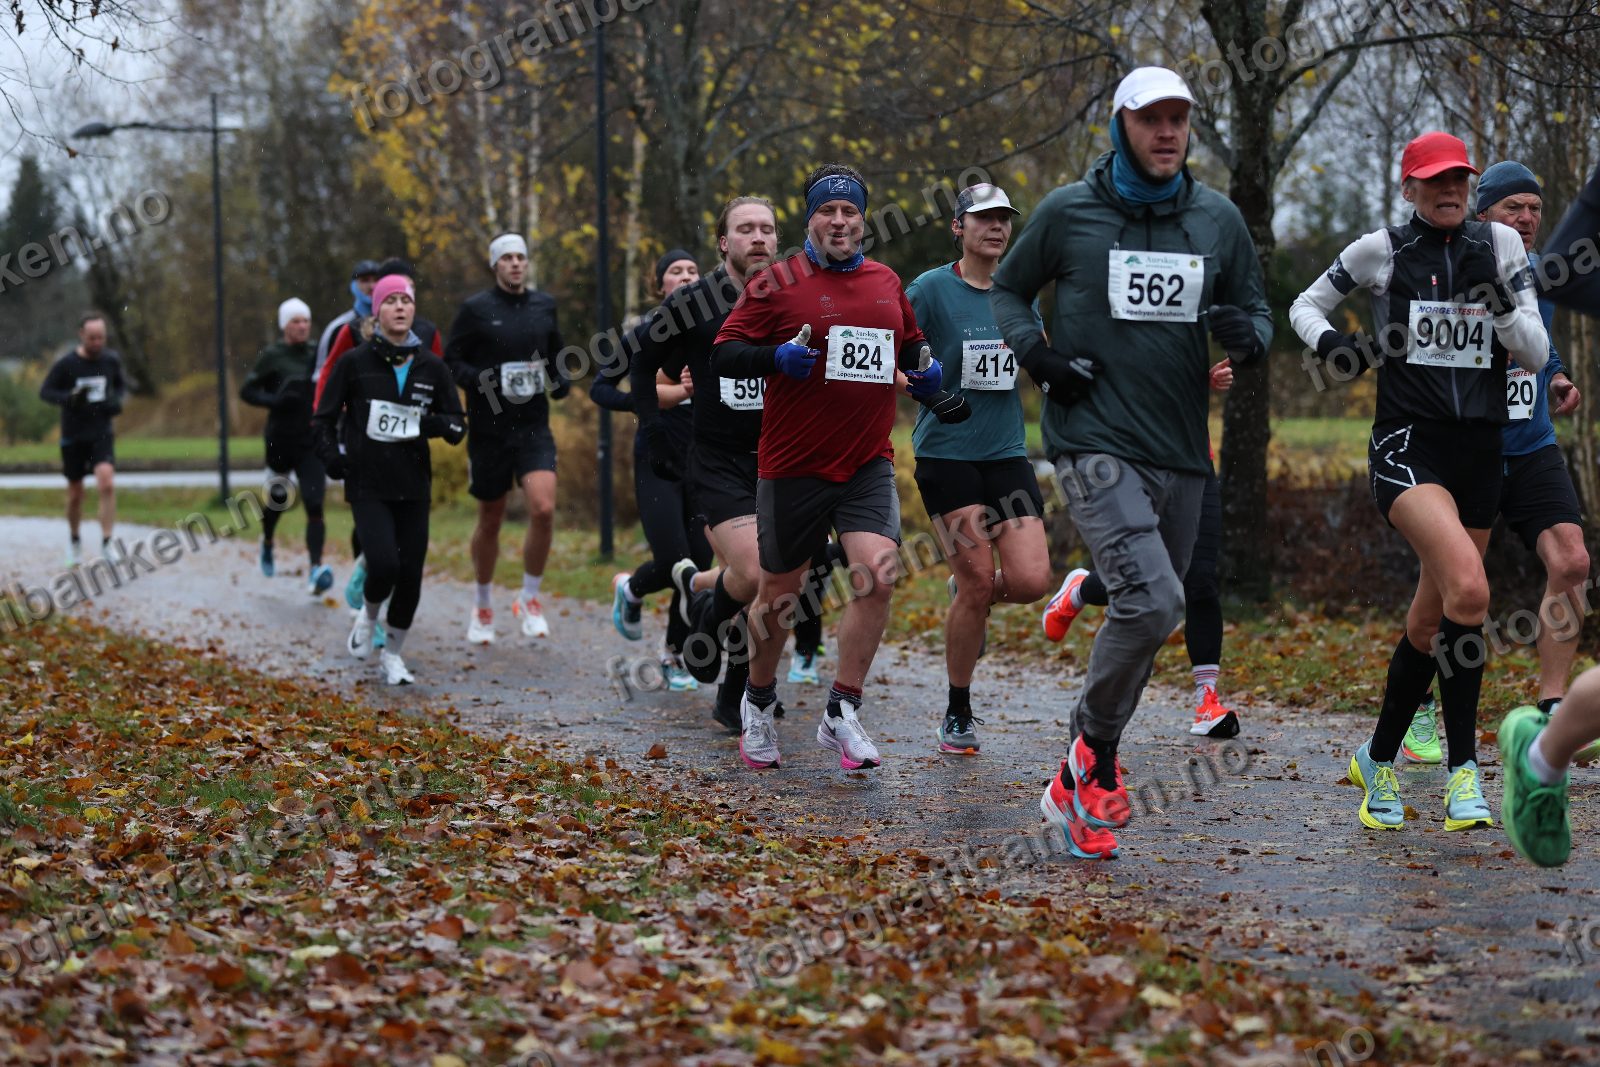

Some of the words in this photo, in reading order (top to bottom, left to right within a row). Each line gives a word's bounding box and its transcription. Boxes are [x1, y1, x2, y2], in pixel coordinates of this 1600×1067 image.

[1127, 273, 1185, 307] 562
[1417, 306, 1487, 317] NORGESTESTEN
[1416, 317, 1484, 351] 9004
[841, 342, 883, 371] 824
[975, 353, 1015, 378] 414
[378, 414, 408, 435] 671
